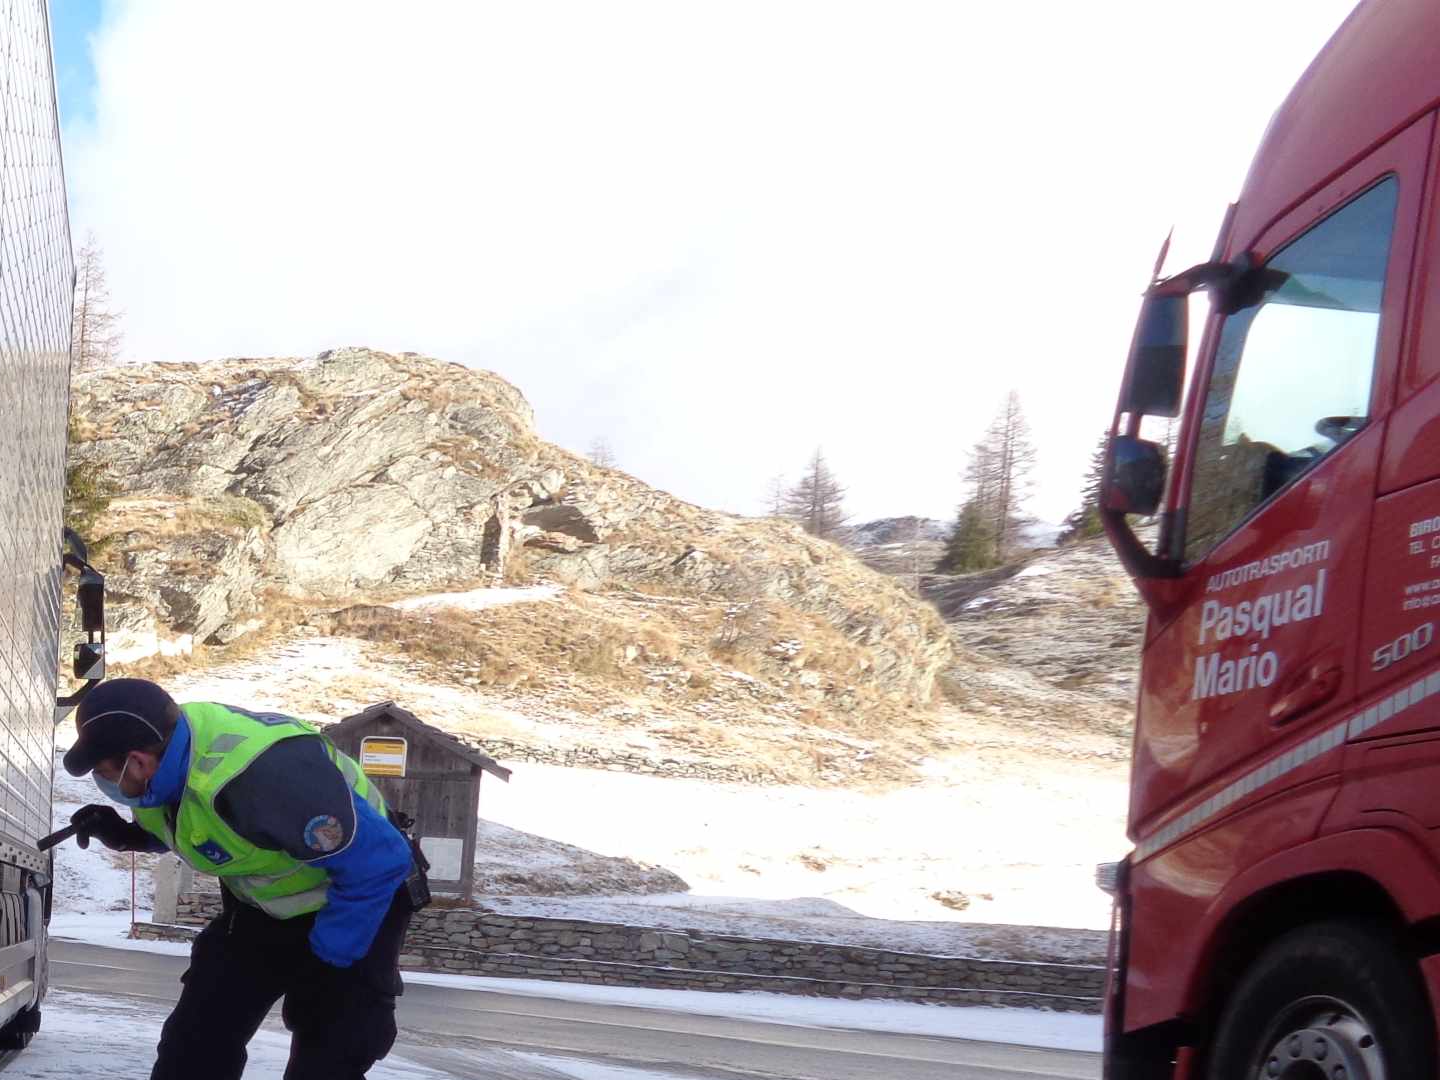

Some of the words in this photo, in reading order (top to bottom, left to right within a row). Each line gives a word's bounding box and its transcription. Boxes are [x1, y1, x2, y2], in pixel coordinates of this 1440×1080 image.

[1206, 540, 1329, 593] AUTOTRASPORTI
[1199, 569, 1327, 645] Pasqual
[1192, 643, 1279, 700] Mario
[1372, 622, 1434, 672] 500
